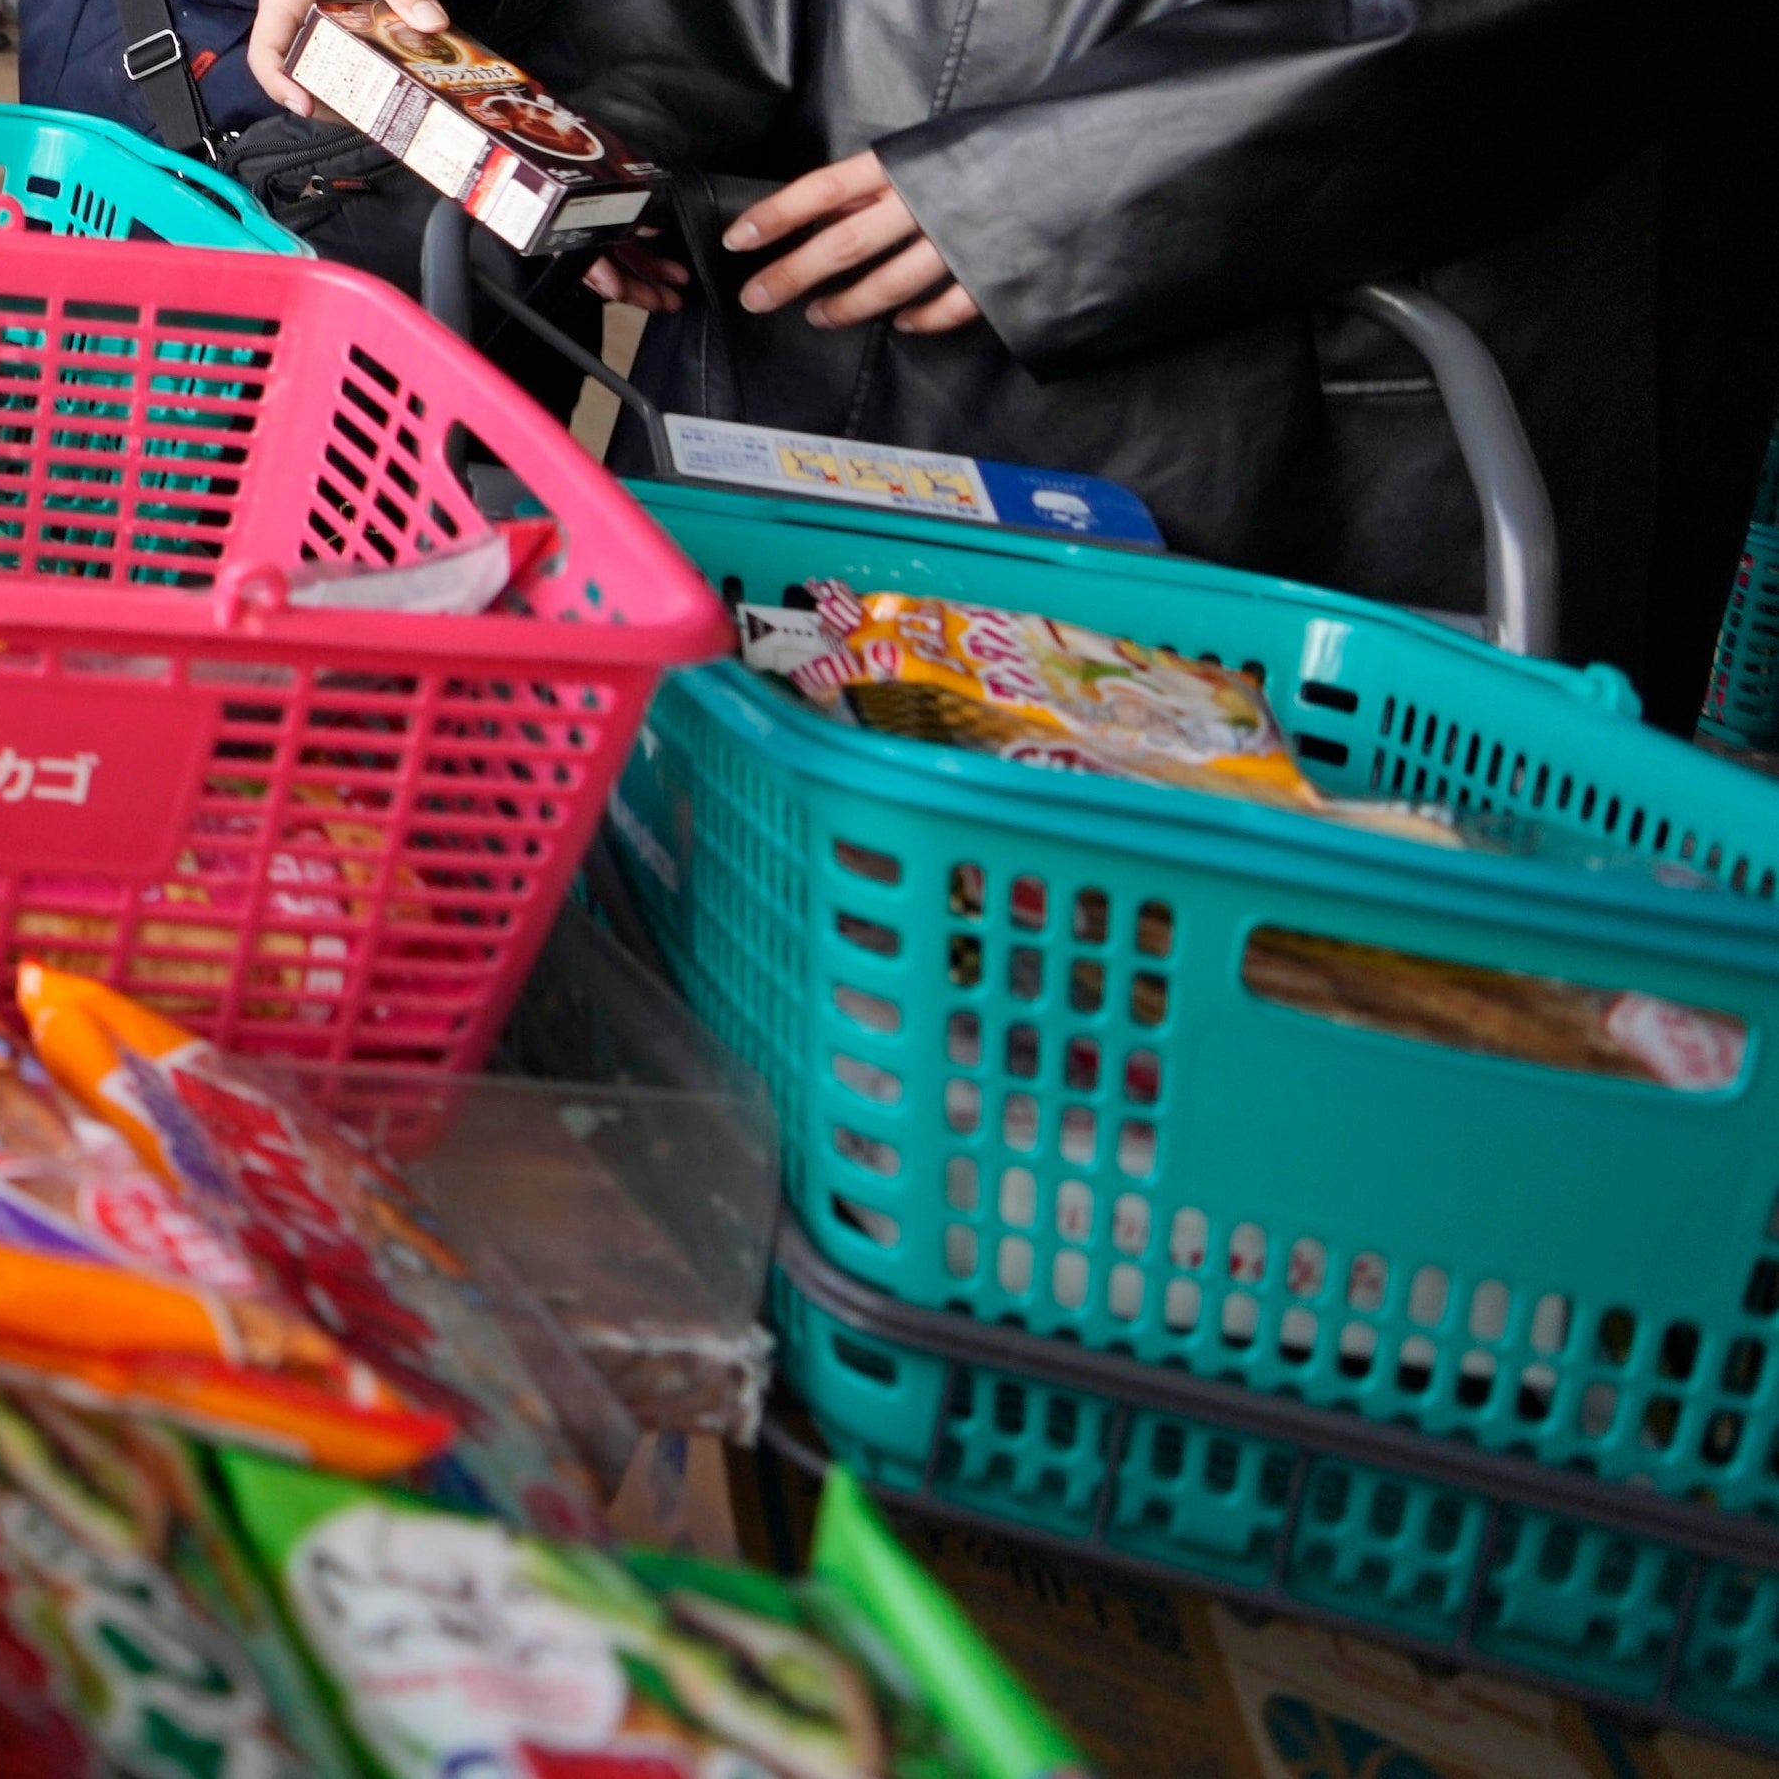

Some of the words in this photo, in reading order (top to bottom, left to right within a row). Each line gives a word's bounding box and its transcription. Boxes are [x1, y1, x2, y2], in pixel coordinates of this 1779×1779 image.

[421, 63, 515, 83] グランカカオ
